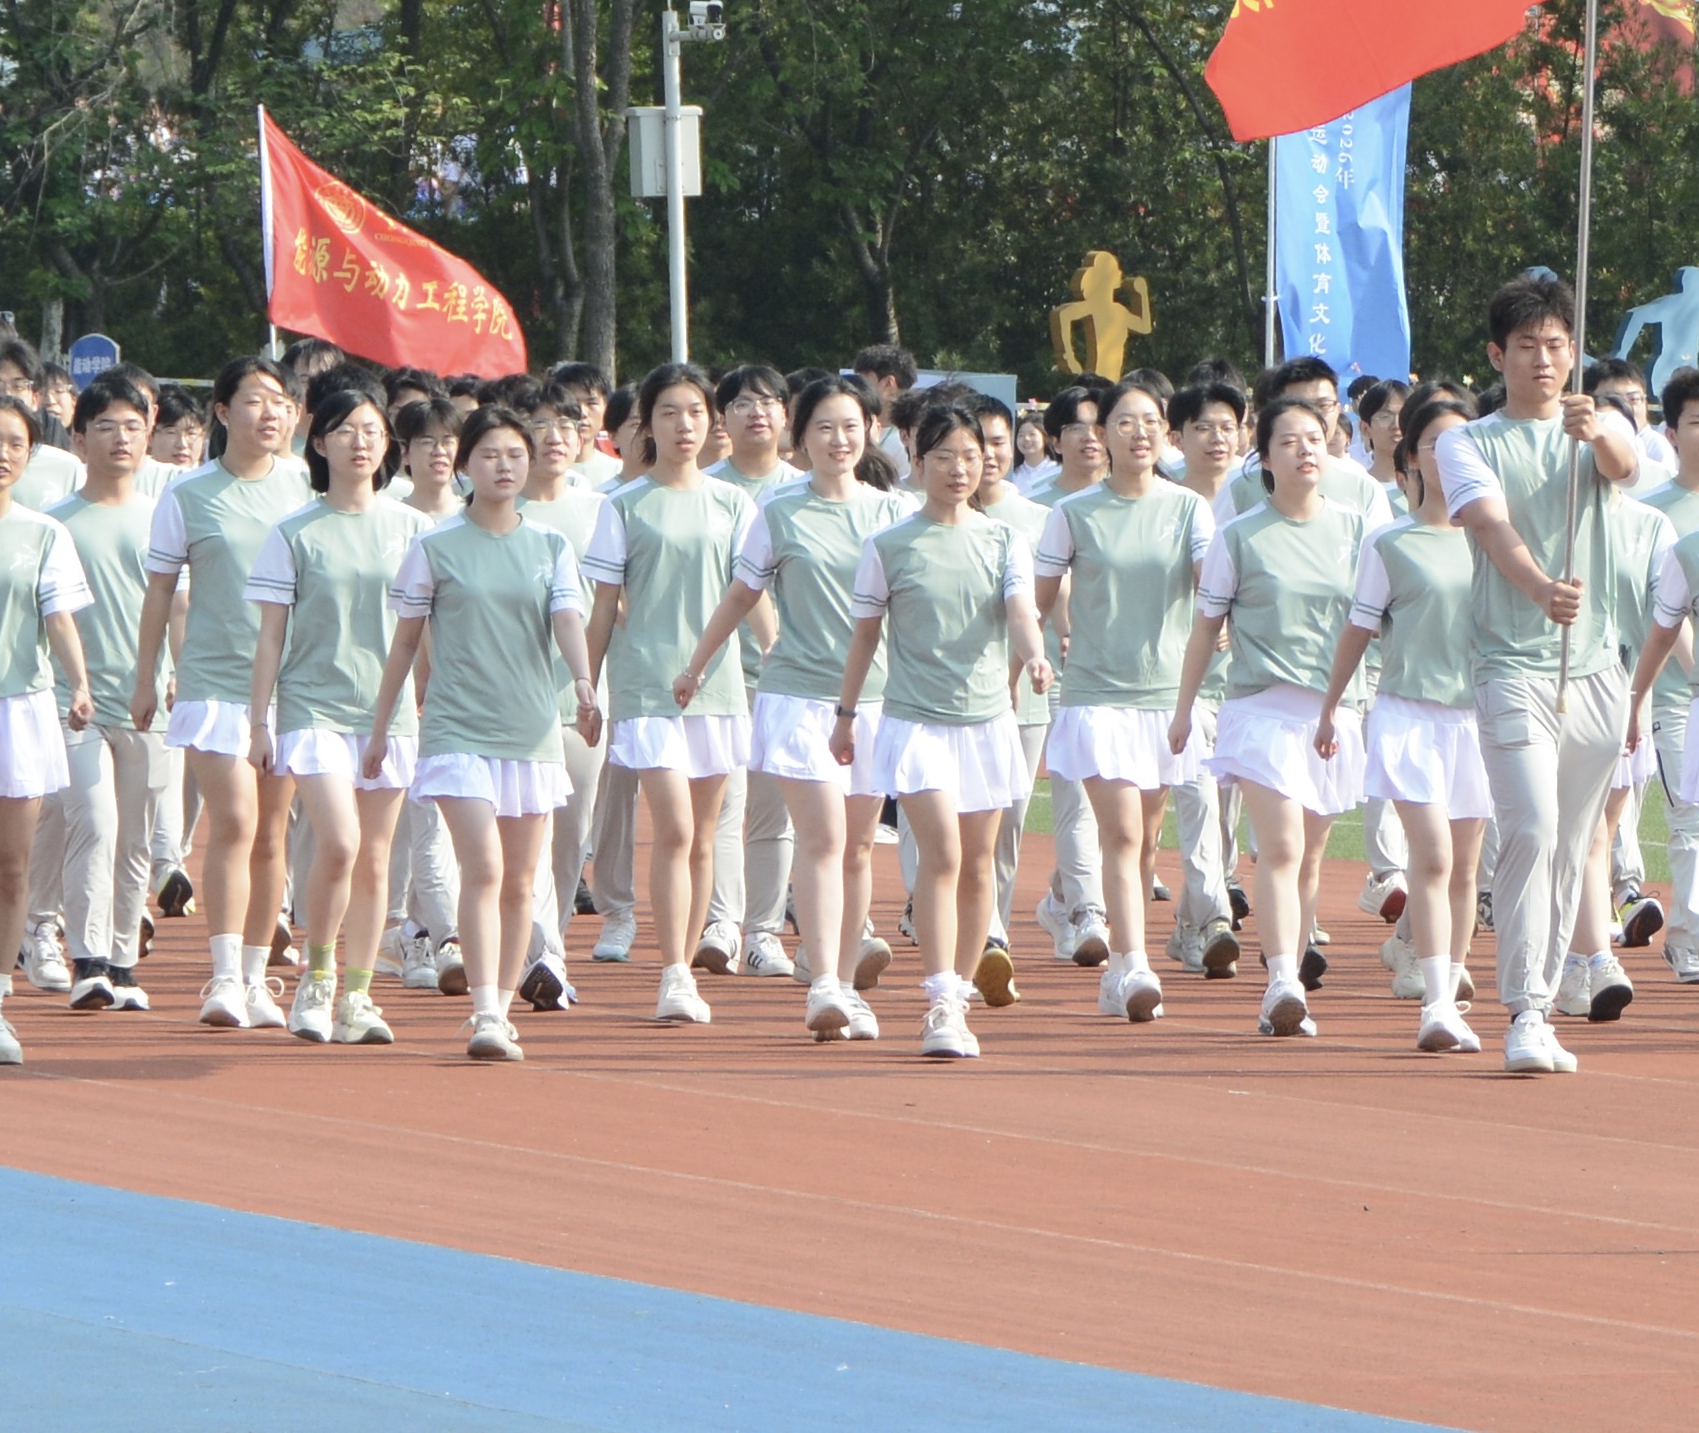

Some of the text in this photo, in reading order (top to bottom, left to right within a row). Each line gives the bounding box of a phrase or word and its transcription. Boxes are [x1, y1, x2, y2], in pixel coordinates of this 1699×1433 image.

[293, 227, 514, 340] 能源与动力工程学院
